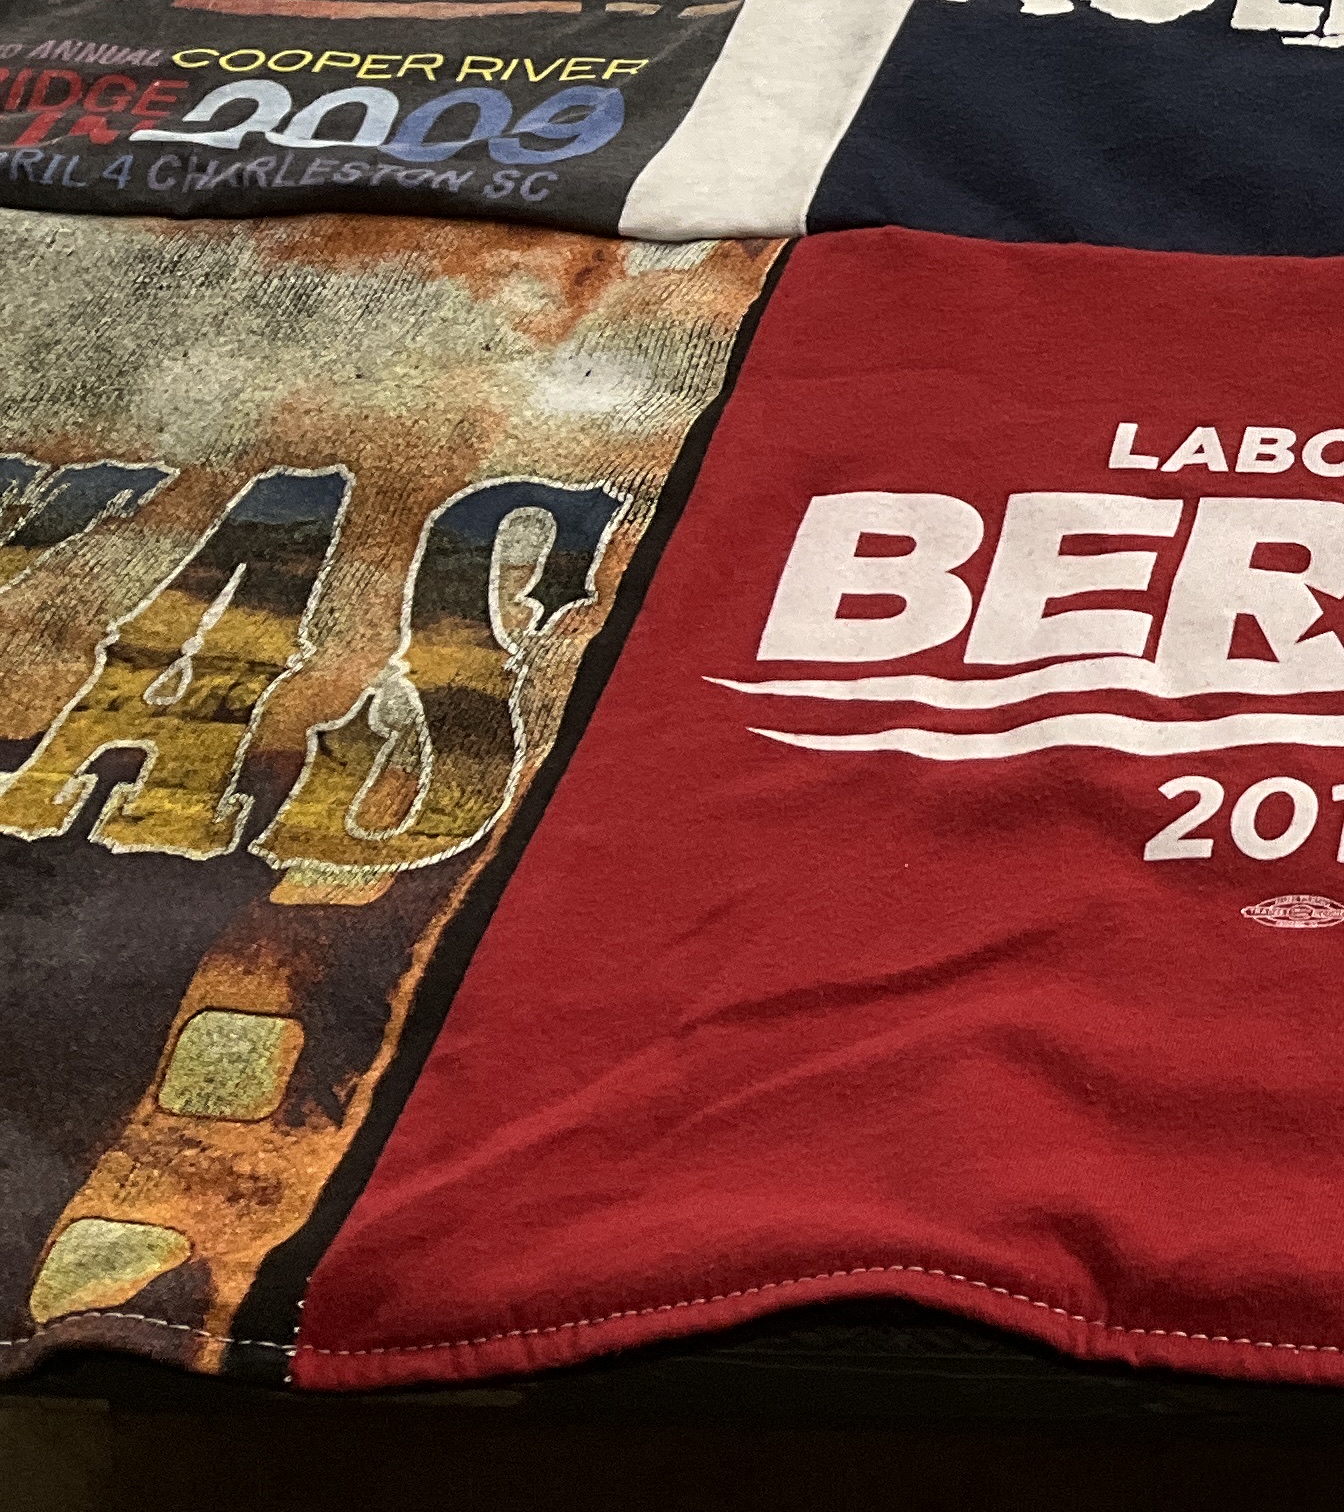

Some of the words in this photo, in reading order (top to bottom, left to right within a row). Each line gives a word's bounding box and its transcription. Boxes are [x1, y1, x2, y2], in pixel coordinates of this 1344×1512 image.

[26, 39, 166, 67] ANNUAL
[171, 47, 446, 81] COOPER
[456, 55, 651, 83] RIVER
[129, 78, 627, 165] 2009
[102, 153, 134, 190] 4
[148, 149, 476, 194] CHARLESTON
[482, 169, 561, 203] SC
